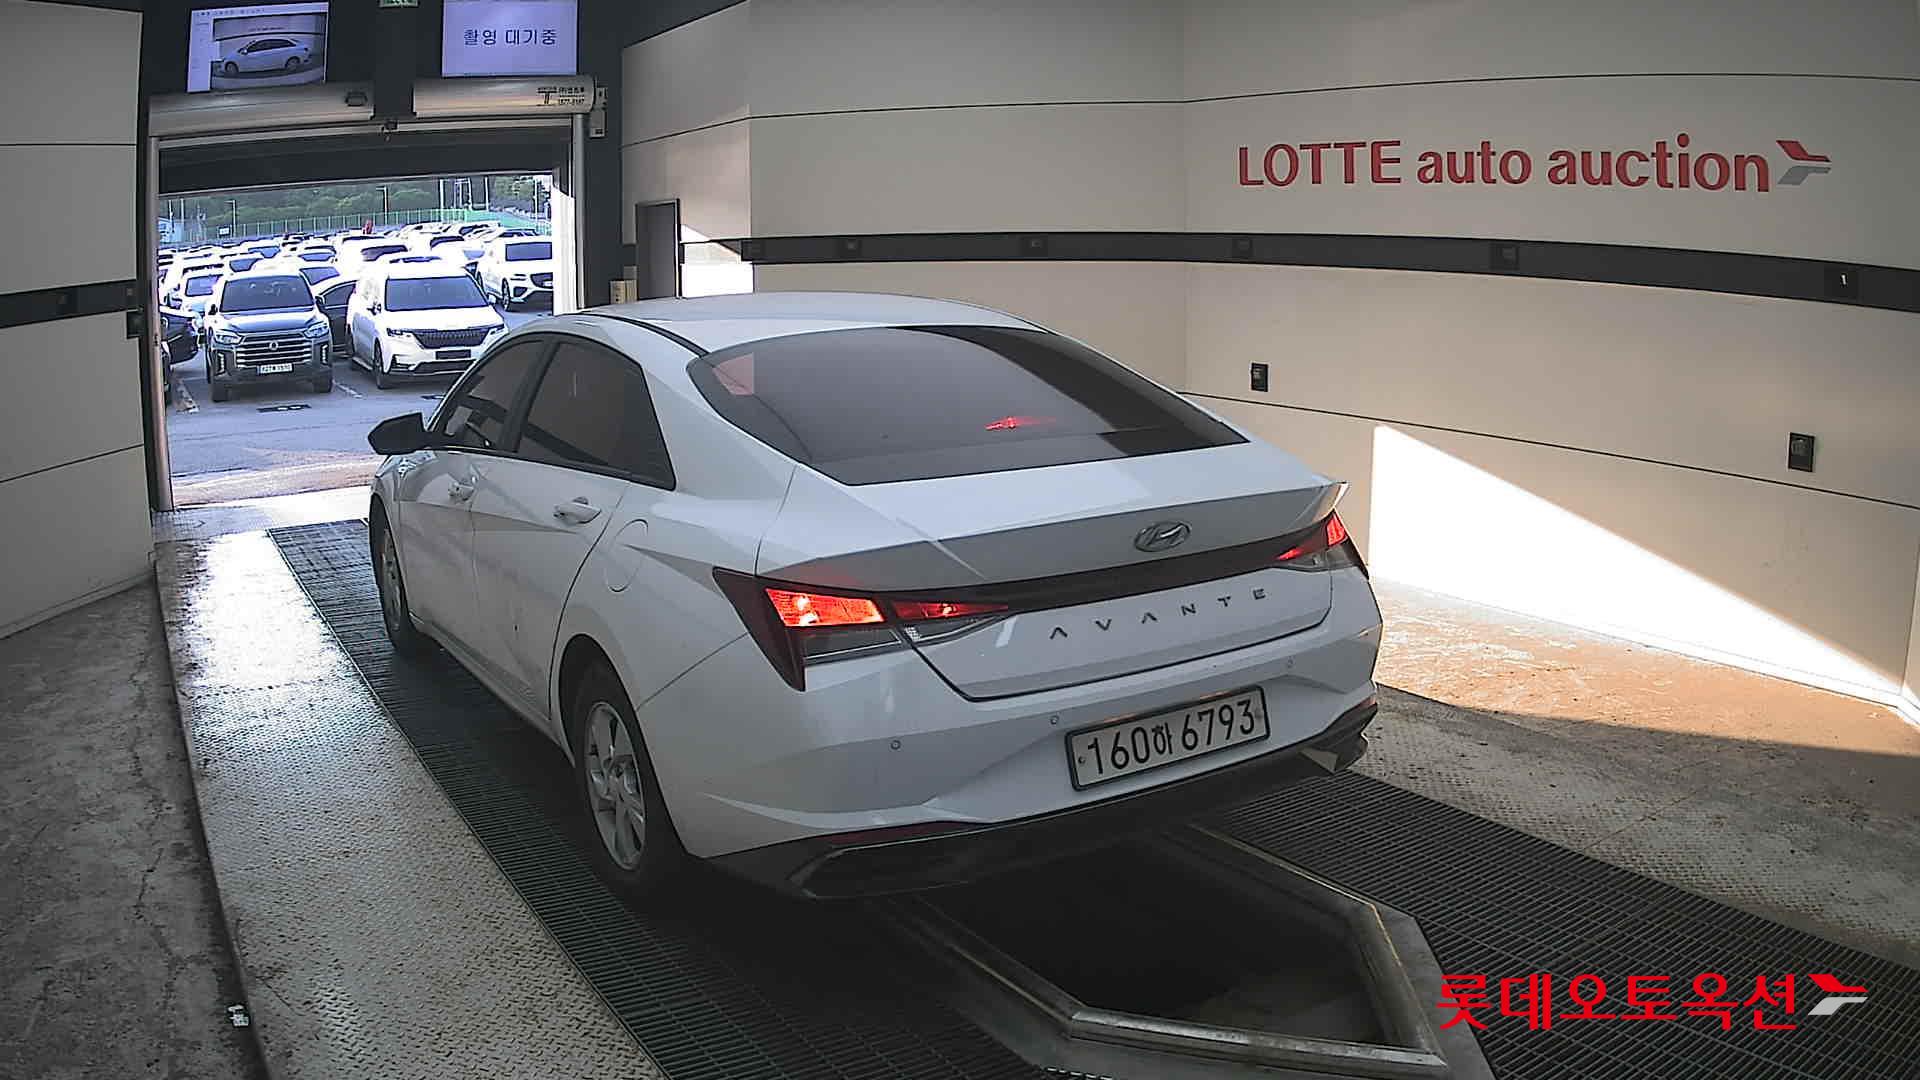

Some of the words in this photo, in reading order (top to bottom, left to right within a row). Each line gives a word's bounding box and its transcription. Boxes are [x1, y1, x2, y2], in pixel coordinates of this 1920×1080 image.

[464, 29, 497, 46] 촬영
[505, 29, 557, 46] 대기중
[1240, 140, 1400, 186] LOTTE
[1417, 141, 1532, 185] auto
[1547, 133, 1770, 192] auction
[1049, 587, 1266, 640] AVANTE
[1181, 698, 1255, 751] 6793
